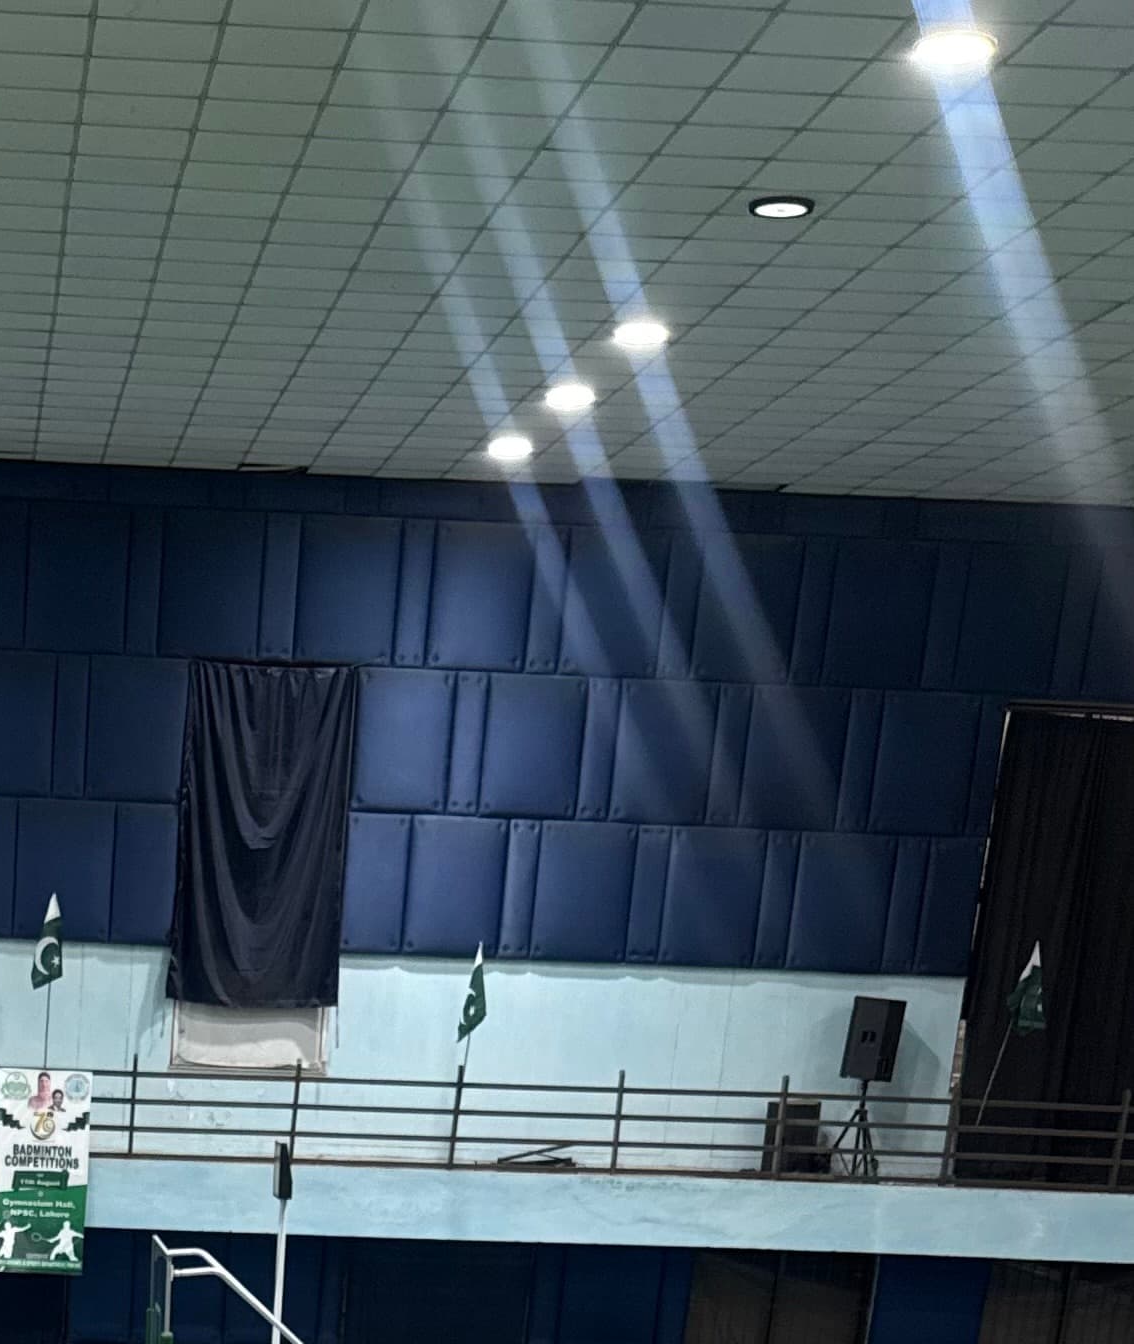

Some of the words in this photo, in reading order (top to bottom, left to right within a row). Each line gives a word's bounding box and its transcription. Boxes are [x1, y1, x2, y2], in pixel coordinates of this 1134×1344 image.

[12, 1143, 72, 1158] BADMINTON
[5, 1154, 79, 1170] COMPETITIONS
[39, 1210, 70, 1218] Lahore
